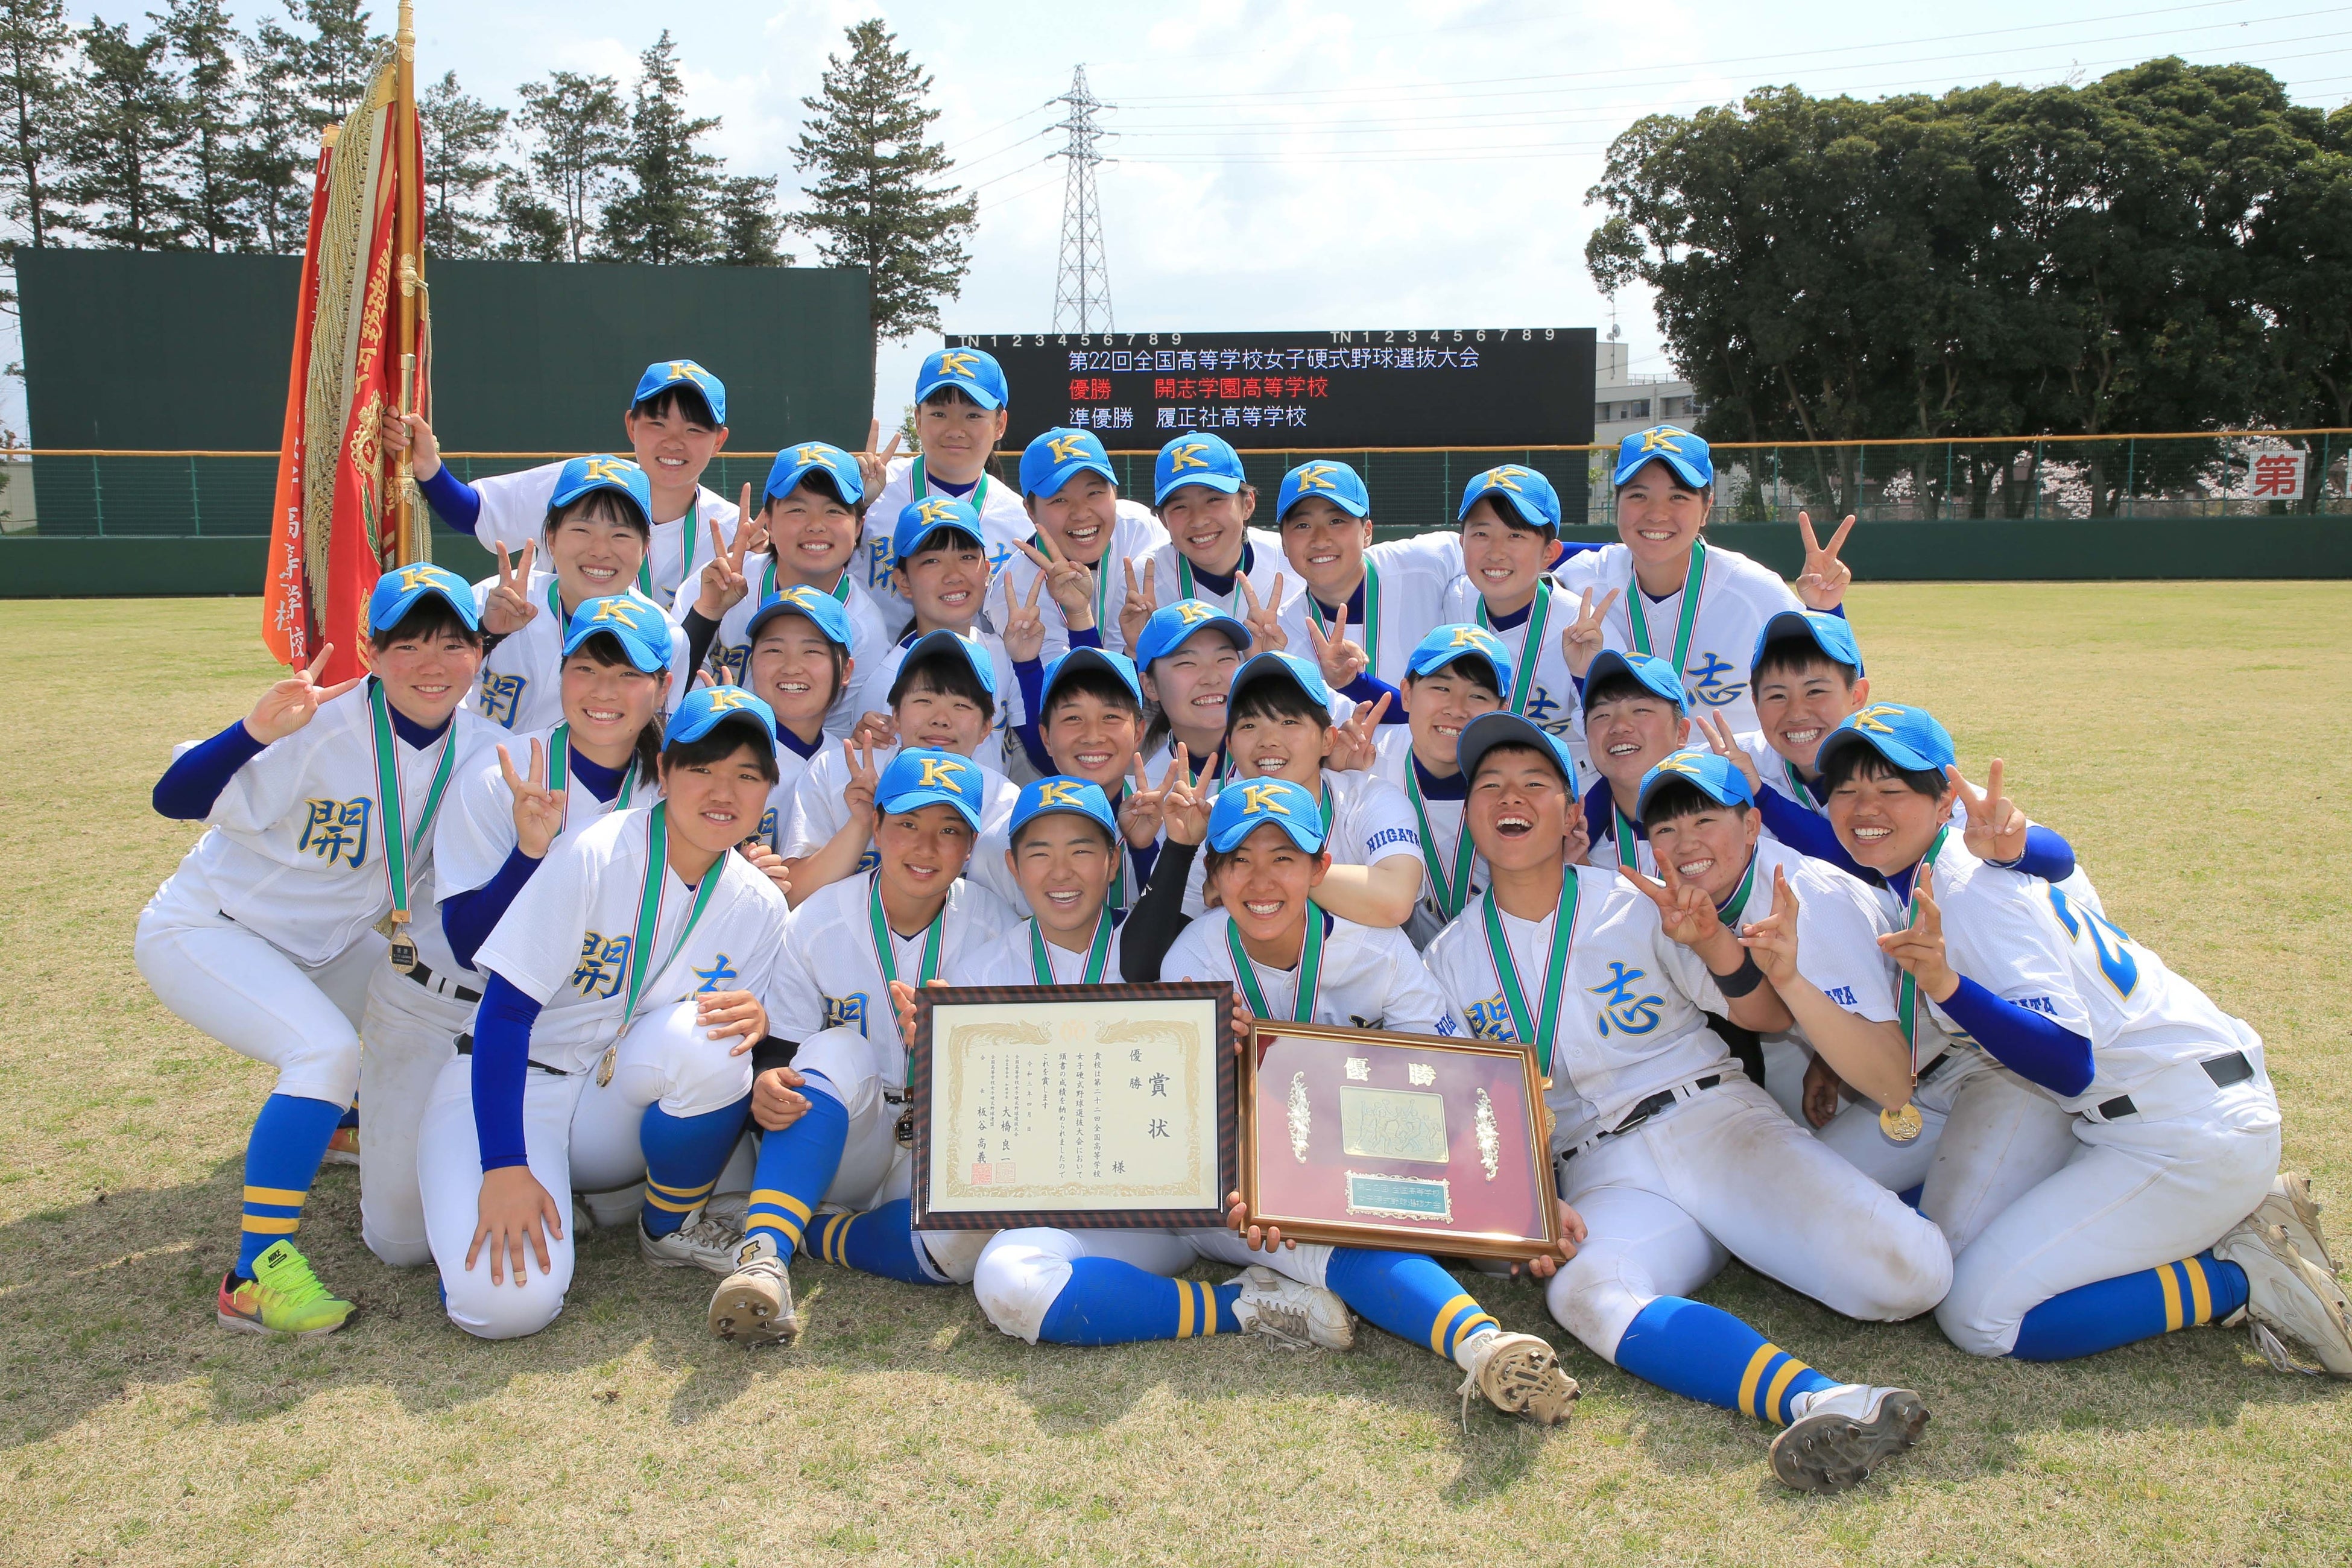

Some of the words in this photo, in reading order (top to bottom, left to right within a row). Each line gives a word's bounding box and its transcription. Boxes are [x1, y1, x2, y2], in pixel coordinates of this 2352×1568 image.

[958, 335, 979, 347] TN
[991, 336, 997, 347] 1
[1012, 335, 1022, 347] 2
[1035, 335, 1045, 347] 3
[1057, 334, 1067, 346] 4
[1080, 334, 1090, 346] 5
[1103, 333, 1113, 345] 6
[1125, 333, 1136, 345] 7
[1148, 332, 1159, 345] 8
[1171, 332, 1181, 344] 9
[1330, 331, 1352, 343] TN
[1362, 330, 1369, 343] 1
[1385, 330, 1394, 343] 2
[1407, 330, 1417, 342] 3
[1430, 330, 1440, 342] 4
[1453, 329, 1463, 341] 5
[1476, 329, 1486, 341] 6
[1499, 329, 1508, 341] 7
[1522, 328, 1532, 341] 8
[1544, 328, 1555, 341] 9
[938, 352, 980, 379] K
[1069, 346, 1479, 371] 第22回全国高等学校女子硬式野球選抜大会
[666, 361, 709, 390] K
[1069, 378, 1111, 400] 優勝
[1155, 376, 1329, 400] 開志学園高等学校
[1069, 406, 1134, 429] 準優勝
[1155, 405, 1307, 429] 履正社高等学校
[1046, 435, 1091, 464] K
[1640, 429, 1687, 454] K
[796, 445, 838, 469] K
[1171, 444, 1209, 473] K
[584, 459, 632, 487] K
[1297, 466, 1338, 493] K
[1483, 467, 1528, 493] K
[2253, 454, 2299, 497] 第
[920, 499, 969, 525] K
[399, 567, 450, 592] K
[592, 599, 645, 630] K
[1175, 603, 1214, 625] K
[1450, 628, 1495, 656] K
[1687, 650, 1748, 707] 志
[709, 690, 756, 712] K
[1852, 706, 1905, 734] K
[918, 758, 966, 793] K
[1657, 753, 1704, 774] K
[1039, 782, 1084, 808] K
[1242, 785, 1291, 815] K
[298, 795, 376, 870] 開
[1366, 828, 1421, 855] NIIGATA
[1584, 959, 1666, 1038] 志
[1042, 1053, 1050, 1110] これを賞します
[1129, 1048, 1142, 1090] 優勝
[1343, 1057, 1438, 1087] 優勝
[1075, 1052, 1085, 1178] 女子硬式野球選抜大会において
[1093, 1051, 1102, 1178] 貴校は第二十二回全国高等学校
[1148, 1072, 1171, 1139] 賞状
[1111, 1160, 1127, 1174] 様
